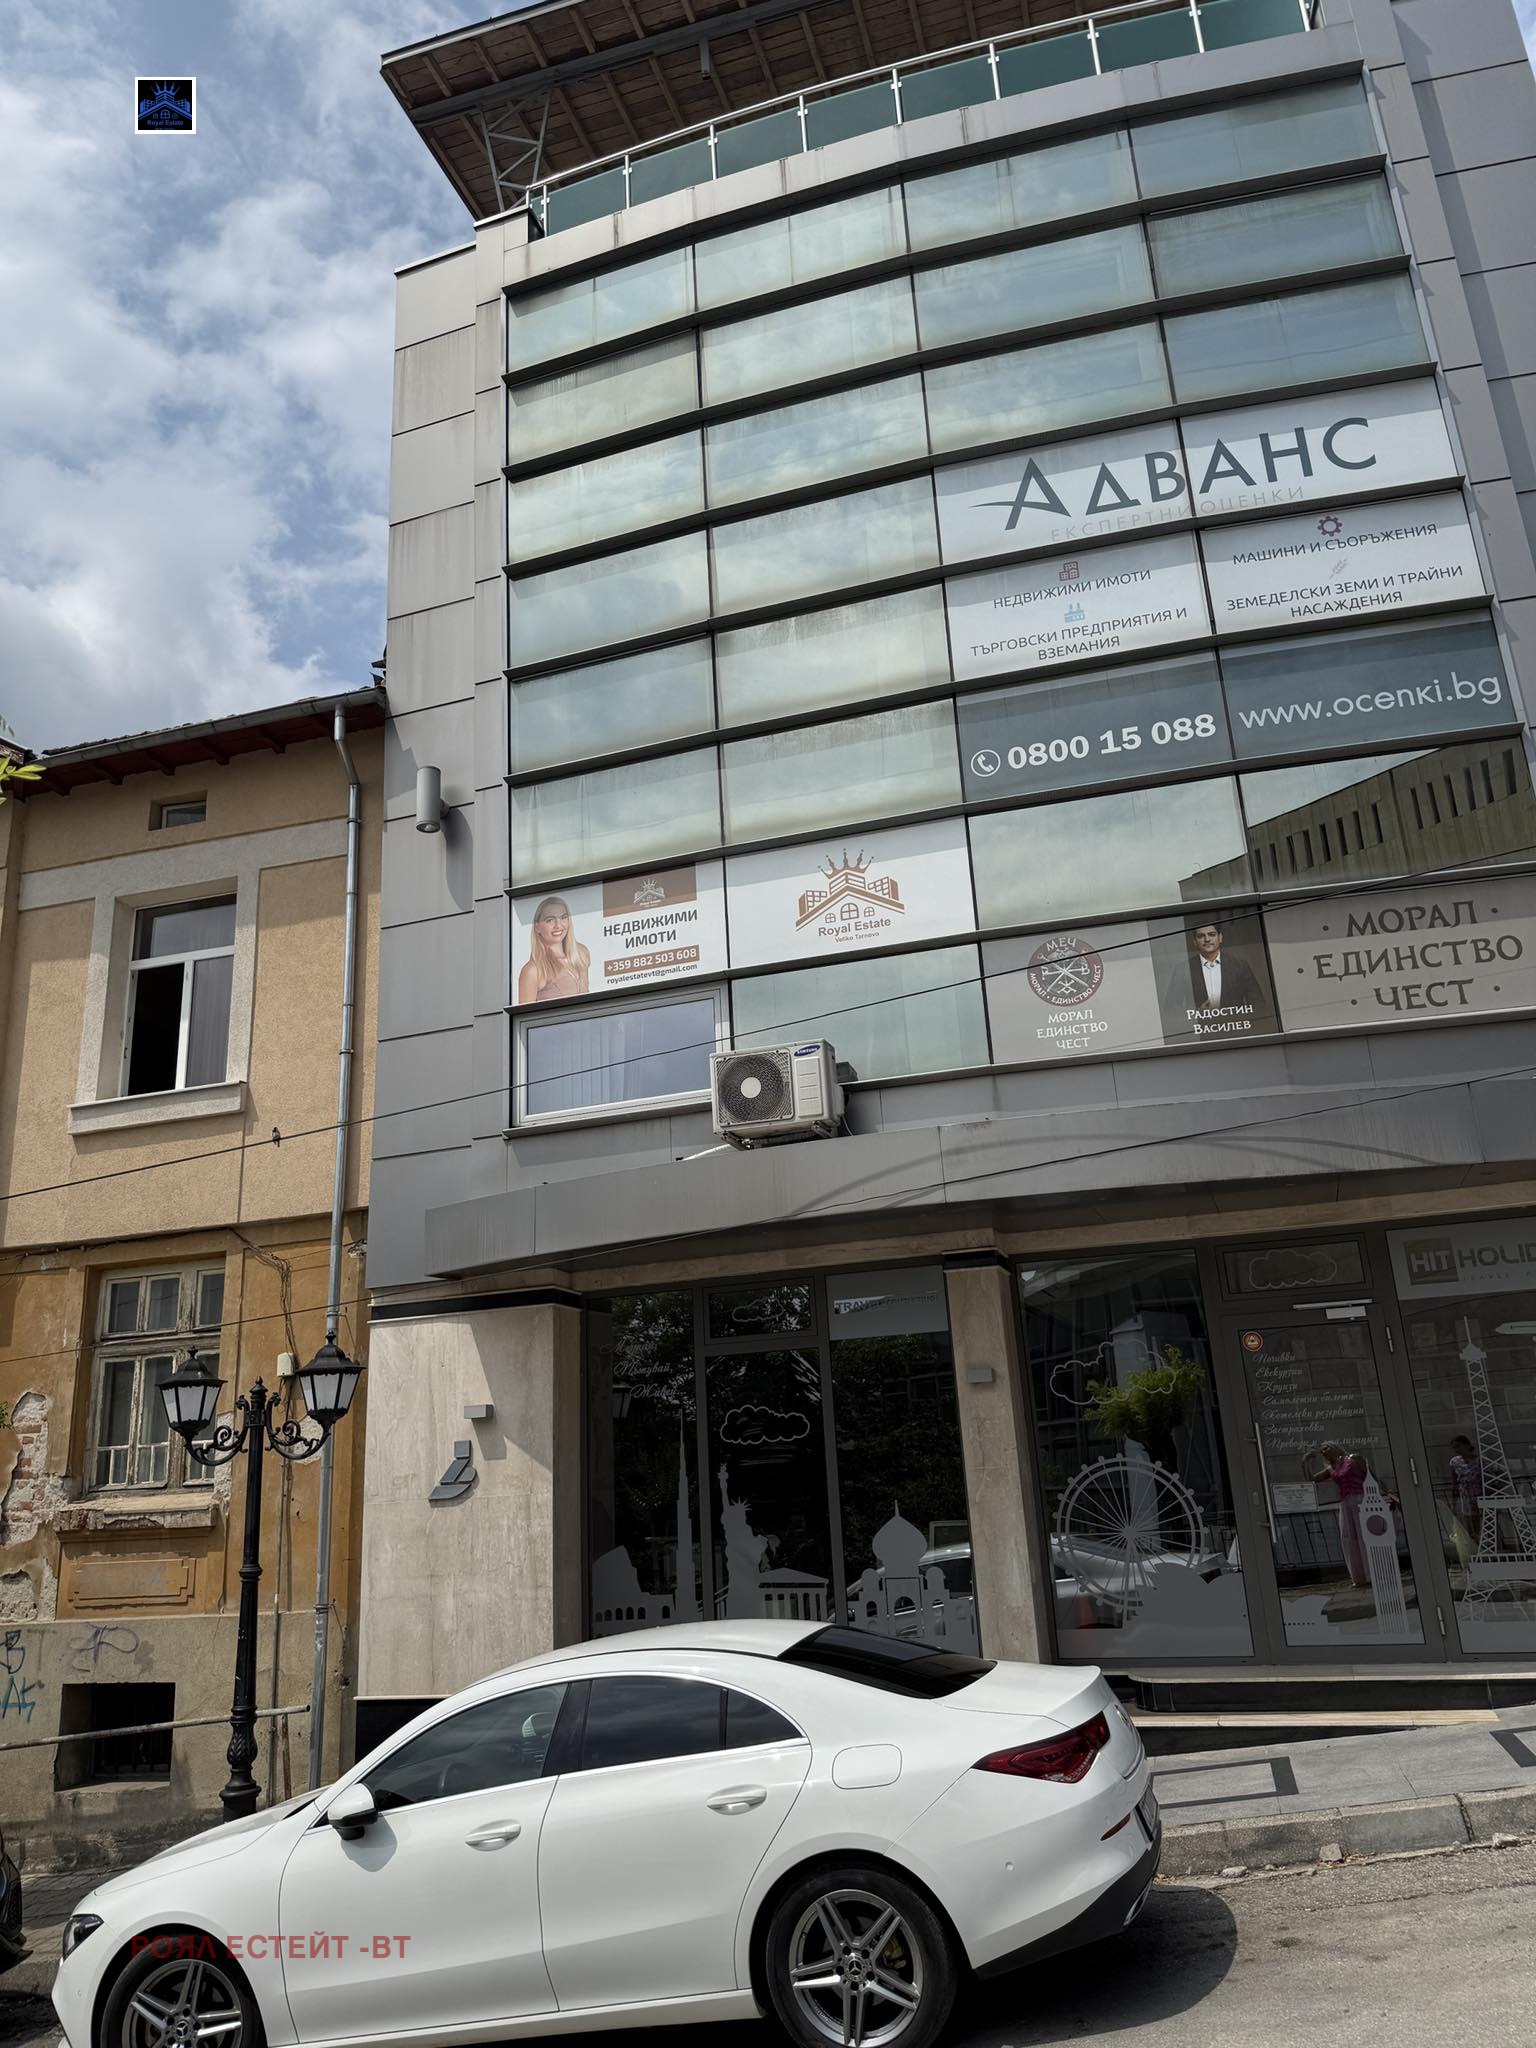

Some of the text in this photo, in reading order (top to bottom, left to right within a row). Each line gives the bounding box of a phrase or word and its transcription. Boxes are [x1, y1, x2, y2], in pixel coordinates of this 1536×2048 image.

[970, 417, 1377, 531] АДВАНС
[1052, 488, 1304, 541] ЕКСПЕРТНИ ОЦЕНКИ
[1232, 523, 1438, 565] МАШИНИ И СЪОРЪЖЕНИЯ
[993, 569, 1151, 609] НЕДВИЖИМИ ИМОТИ
[1226, 565, 1463, 611] ЗЕМЕДЕЛСКИ ЗЕМИ И ТРАЙНИ
[1291, 591, 1403, 618] НАСАЖДЕНИЯ
[970, 607, 1188, 657] ТЪРГОВСКИ ПРЕДПРИЯТИЯ И
[1038, 636, 1120, 661] ВЗЕМАНИЯ
[1238, 671, 1503, 729] www.ocenki.bg
[1007, 714, 1217, 769] 0800 15 088
[603, 909, 698, 937] НЕДВИЖИМИ
[818, 918, 891, 937] Royal Estate
[1346, 900, 1478, 938] МОРАЛ
[625, 929, 677, 949] ИМОТИ
[1046, 937, 1077, 951] МЕЧ
[607, 948, 697, 972] +359 882 503 608
[1312, 935, 1524, 981] ЕДИНСТВО
[607, 964, 698, 985] royalestatevt@gmail.com
[1029, 964, 1102, 1005] МОРАЛ ЕДИНСТВО ЧЕСТ
[1373, 978, 1475, 1011] ЧЕСТ
[1036, 1021, 1108, 1039] ЕДИНСТВО
[1048, 1009, 1094, 1024] МОРАЛ
[1056, 1037, 1091, 1049] ЧЕСТ
[1410, 1249, 1450, 1273] HIT
